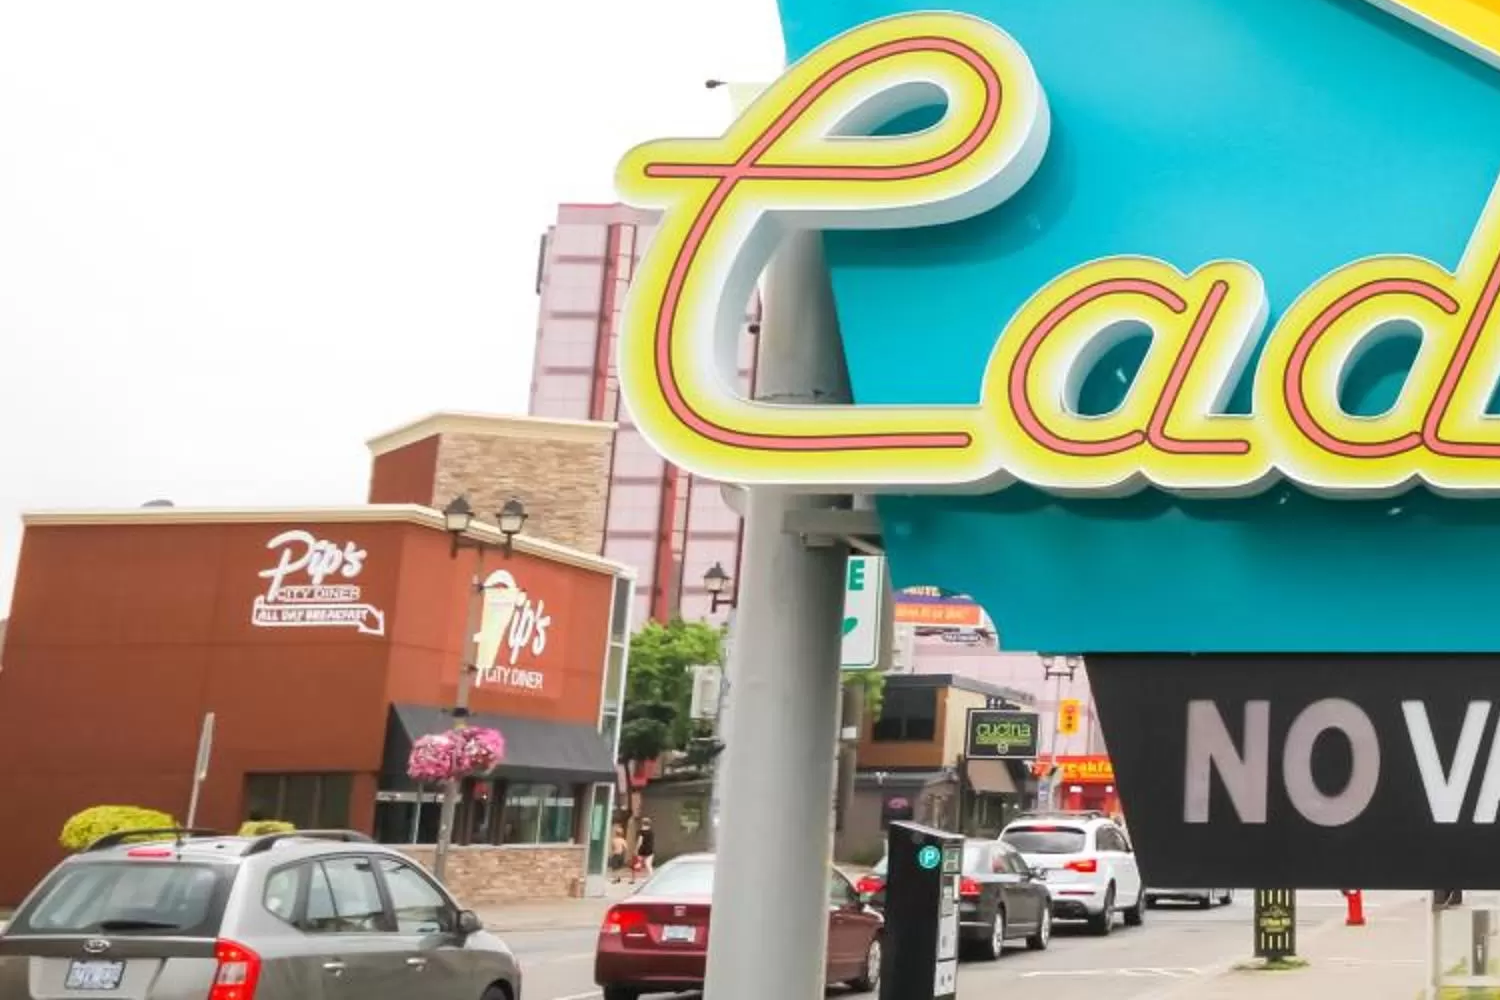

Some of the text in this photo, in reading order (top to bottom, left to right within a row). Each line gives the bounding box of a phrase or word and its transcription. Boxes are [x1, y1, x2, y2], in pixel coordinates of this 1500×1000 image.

[258, 529, 367, 602] Pip's
[315, 586, 361, 601] DINER
[511, 668, 545, 690] DINER
[976, 722, 1031, 737] cucina
[1184, 697, 1381, 827] NO
